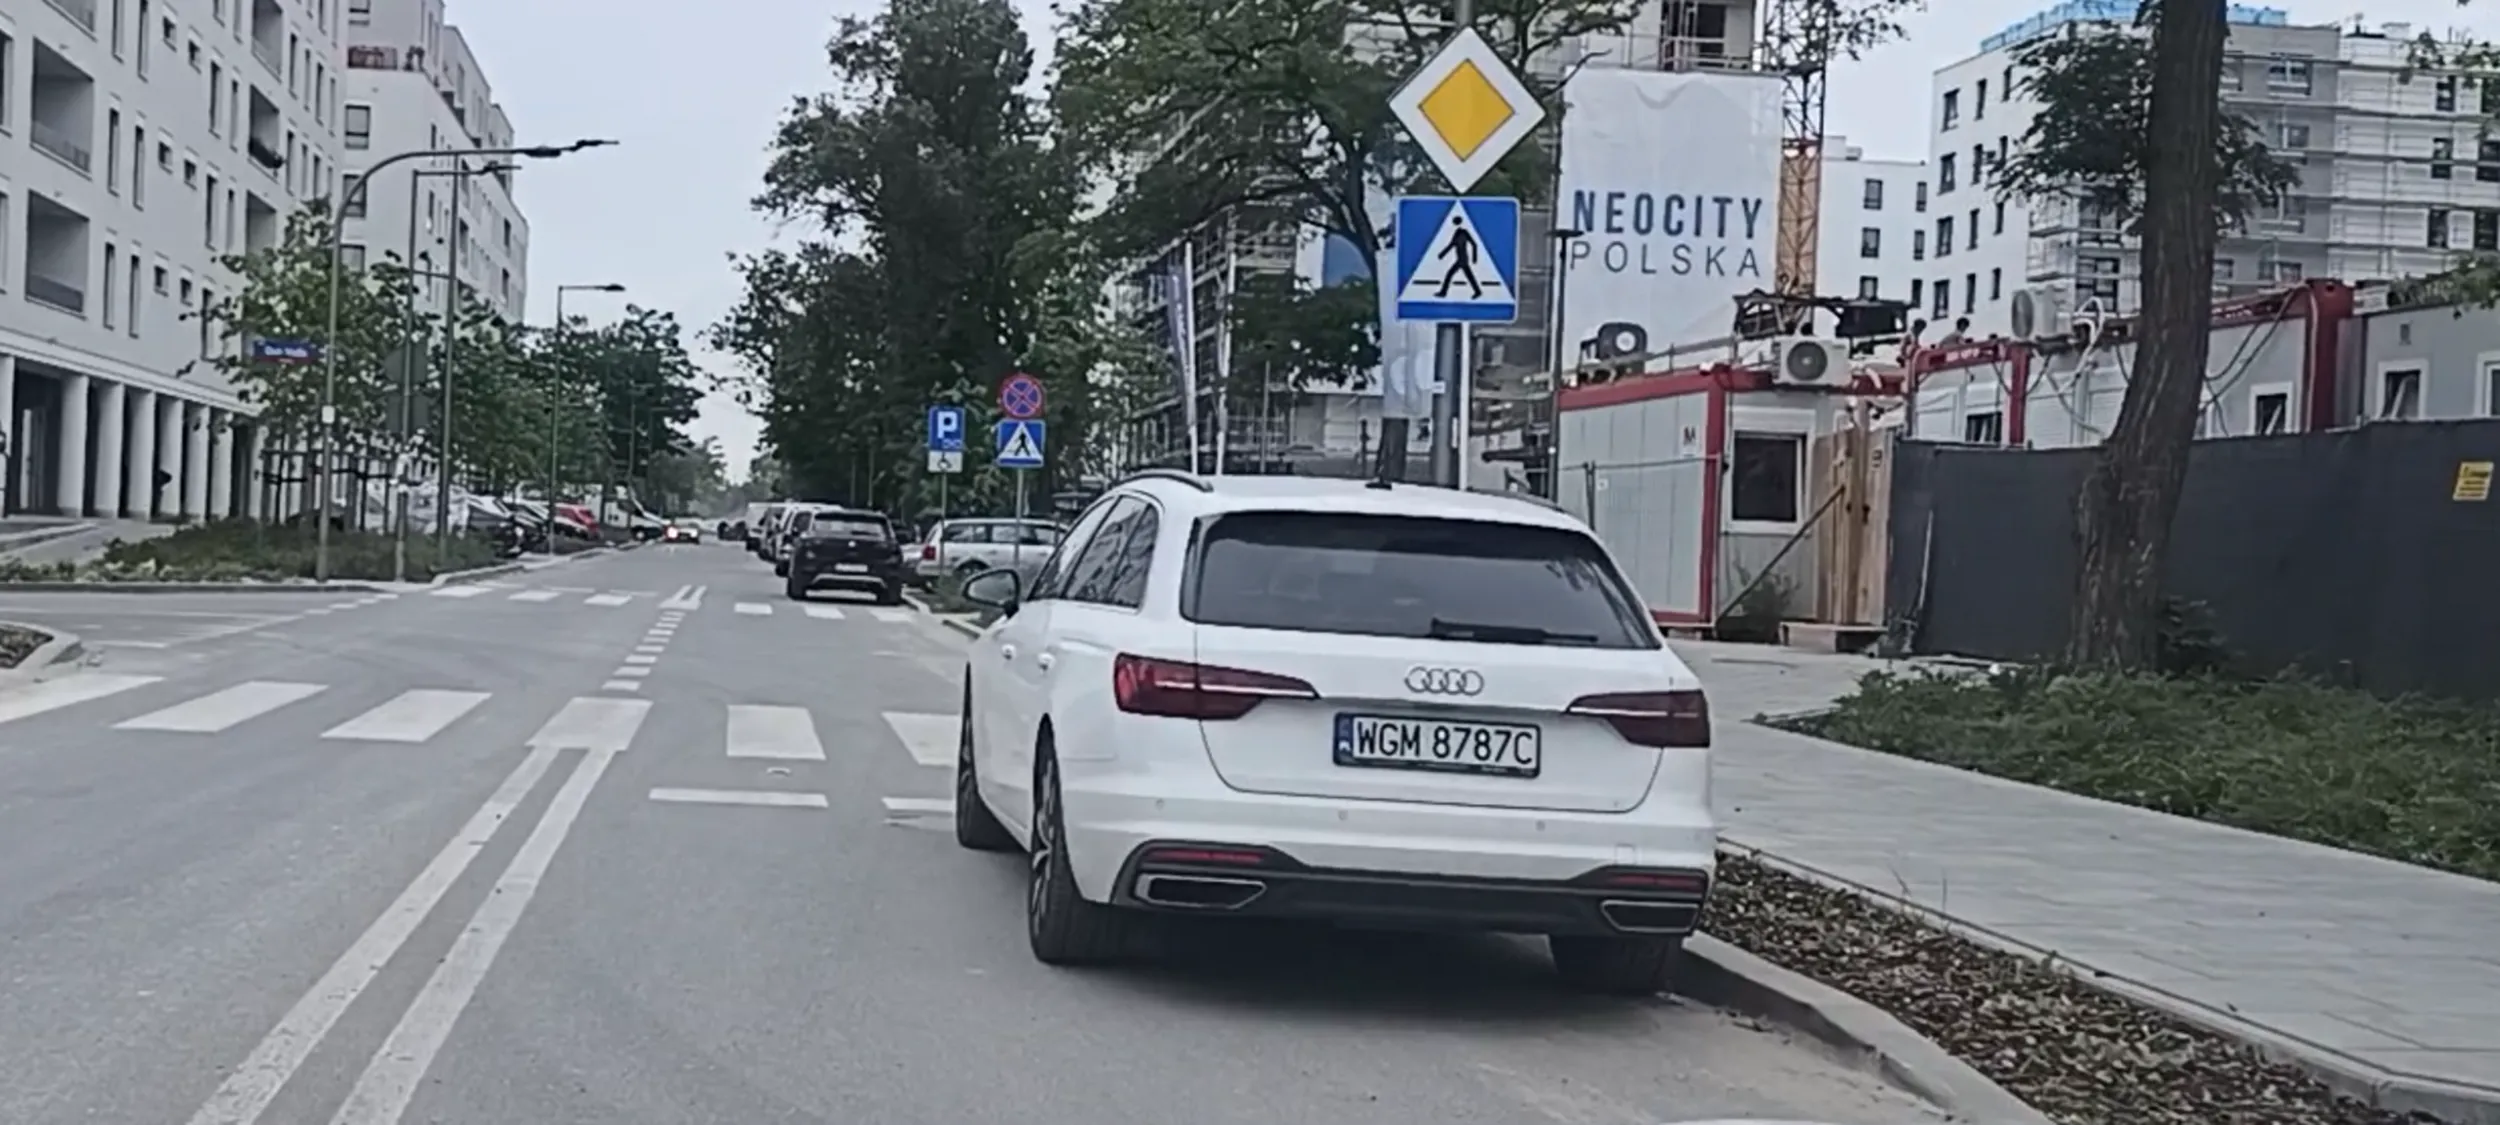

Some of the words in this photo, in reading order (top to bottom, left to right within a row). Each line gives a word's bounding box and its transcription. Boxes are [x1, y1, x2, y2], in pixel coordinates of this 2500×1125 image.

[1574, 190, 1762, 239] NEOCITY
[1570, 240, 1760, 277] POLSKA
[937, 410, 958, 439] P
[1357, 721, 1421, 757] WGM
[1432, 725, 1533, 765] 8787C
